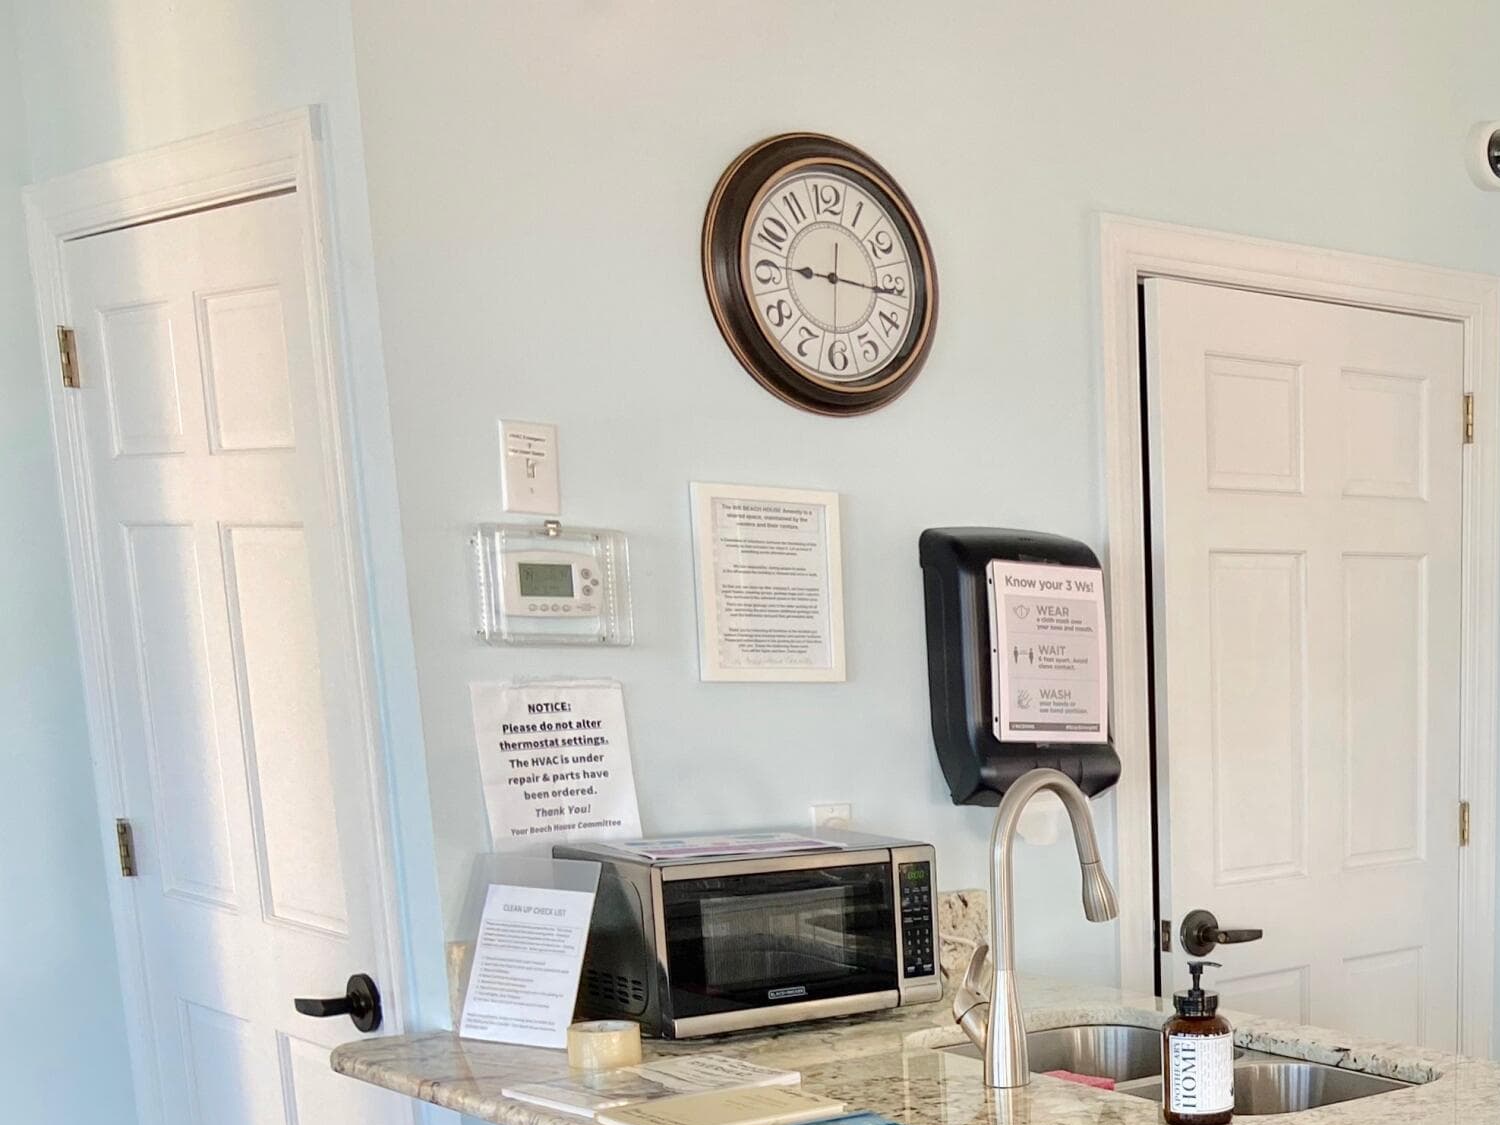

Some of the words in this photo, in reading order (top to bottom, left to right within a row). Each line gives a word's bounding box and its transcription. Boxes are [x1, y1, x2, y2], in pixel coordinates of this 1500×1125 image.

[783, 191, 807, 224] 11
[812, 183, 841, 216] 12
[851, 201, 864, 227] 1
[757, 216, 789, 250] 10
[868, 230, 893, 260] 2
[754, 259, 782, 285] 9
[881, 274, 906, 297] 3
[766, 299, 792, 327] 8
[878, 310, 900, 337] 4
[797, 326, 820, 357] 7
[857, 332, 879, 362] 5
[827, 340, 849, 371] 6
[1005, 575, 1036, 588] Know
[1039, 580, 1063, 591] your
[1066, 580, 1072, 591] 3
[1074, 581, 1094, 592] Ws!
[1036, 605, 1069, 617] WEAR
[1038, 645, 1066, 656] WAIT
[1039, 688, 1071, 699] WASH
[528, 702, 571, 713] NOTICE:
[502, 723, 537, 734] Please
[540, 722, 553, 731] do
[555, 720, 573, 730] not
[576, 719, 602, 729] alter
[499, 738, 560, 751] thermostat
[561, 735, 609, 746] settings.
[509, 759, 529, 769] The
[531, 756, 559, 767] HVAC
[561, 755, 569, 764] is
[572, 753, 605, 763] under
[508, 773, 541, 786] repair
[542, 773, 550, 782] &
[552, 771, 581, 783] parts
[583, 770, 609, 779] have
[524, 791, 550, 800] been
[552, 786, 598, 797] ordered.
[535, 806, 565, 818] Thank
[568, 803, 591, 815] You!
[511, 828, 528, 836] Your
[530, 825, 553, 834] Beach
[554, 823, 576, 831] House
[578, 819, 621, 829] Committee
[503, 904, 522, 912] CLEAN
[523, 905, 533, 913] UP
[533, 907, 553, 915] CHECK
[554, 908, 566, 917] LIST
[1182, 1042, 1196, 1108] HOME
